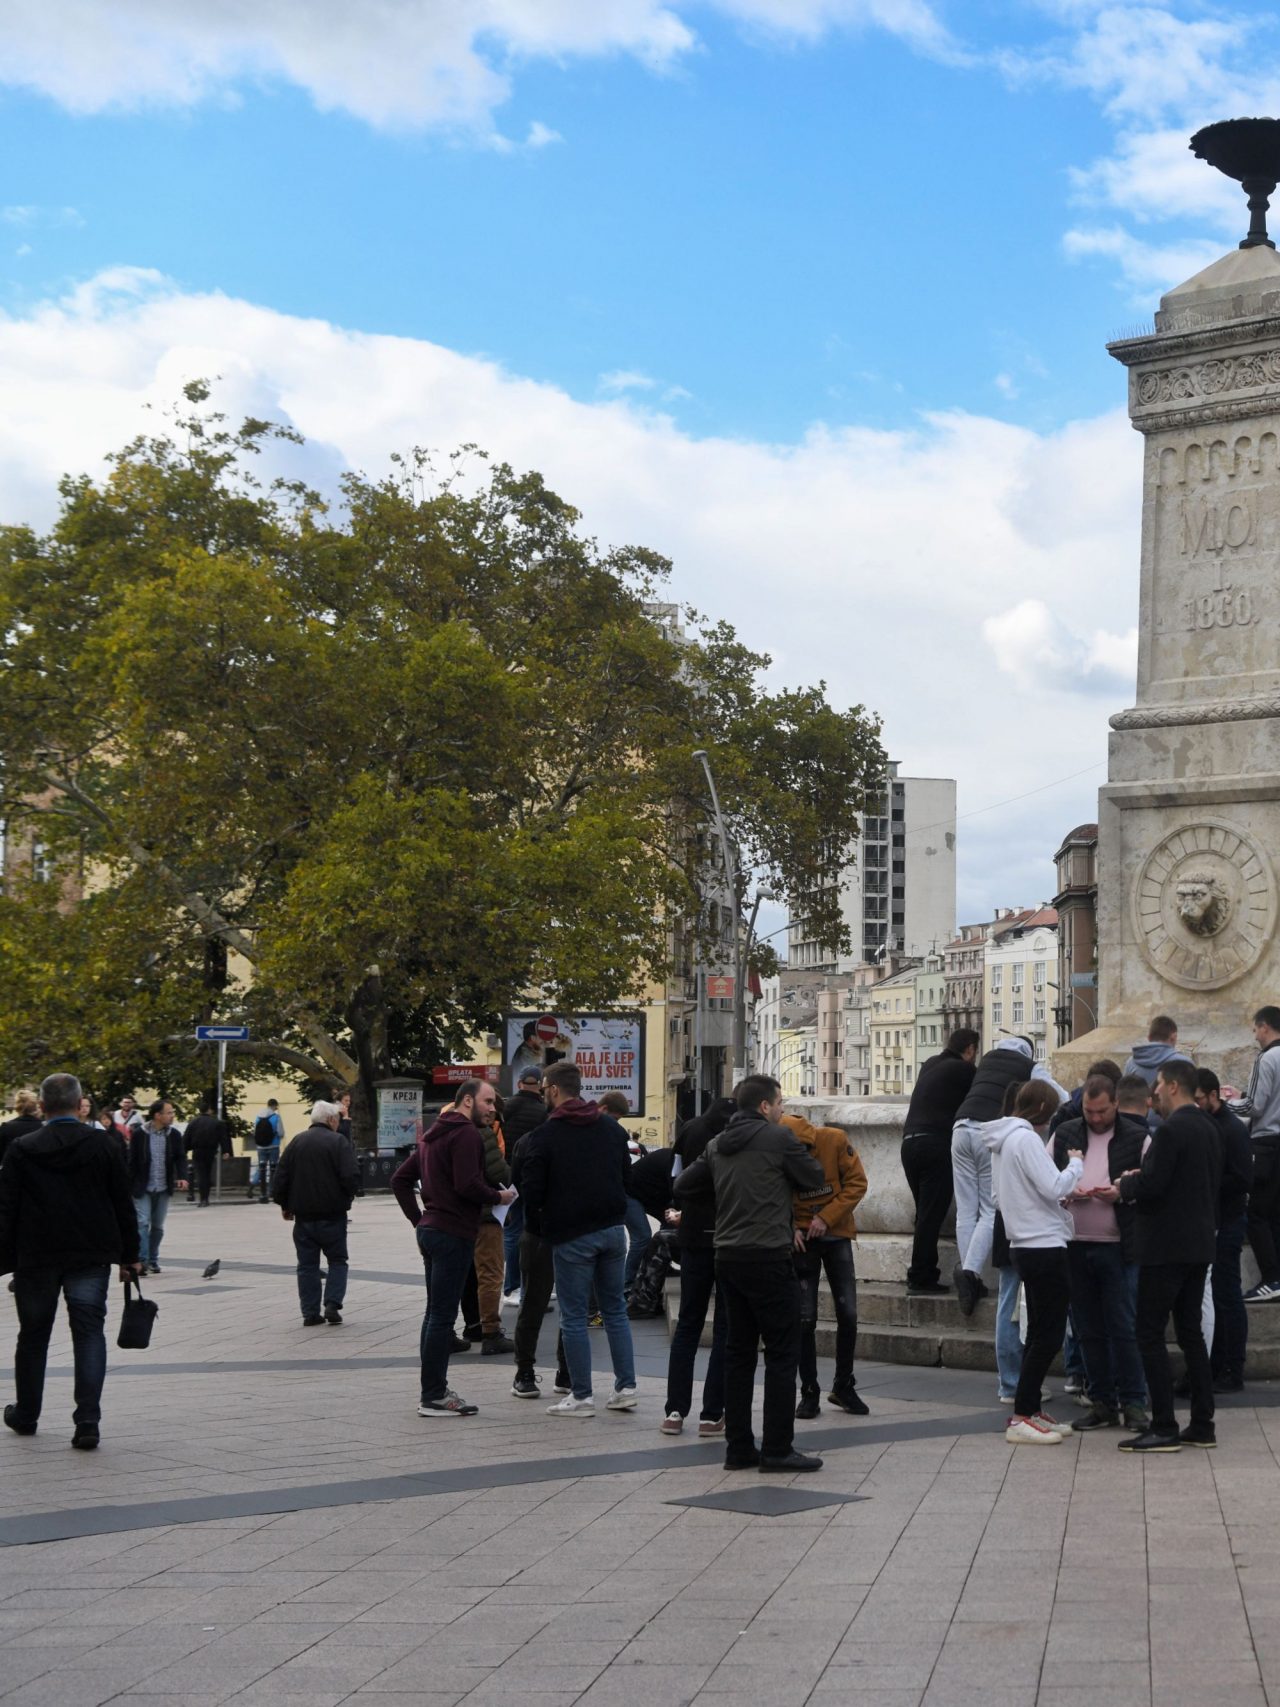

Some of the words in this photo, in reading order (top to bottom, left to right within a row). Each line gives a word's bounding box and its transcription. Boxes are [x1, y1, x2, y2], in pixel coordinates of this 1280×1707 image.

[575, 1052, 596, 1065] ALA
[599, 1052, 611, 1065] JE
[614, 1052, 635, 1065] LEP
[606, 1065, 634, 1078] SVET
